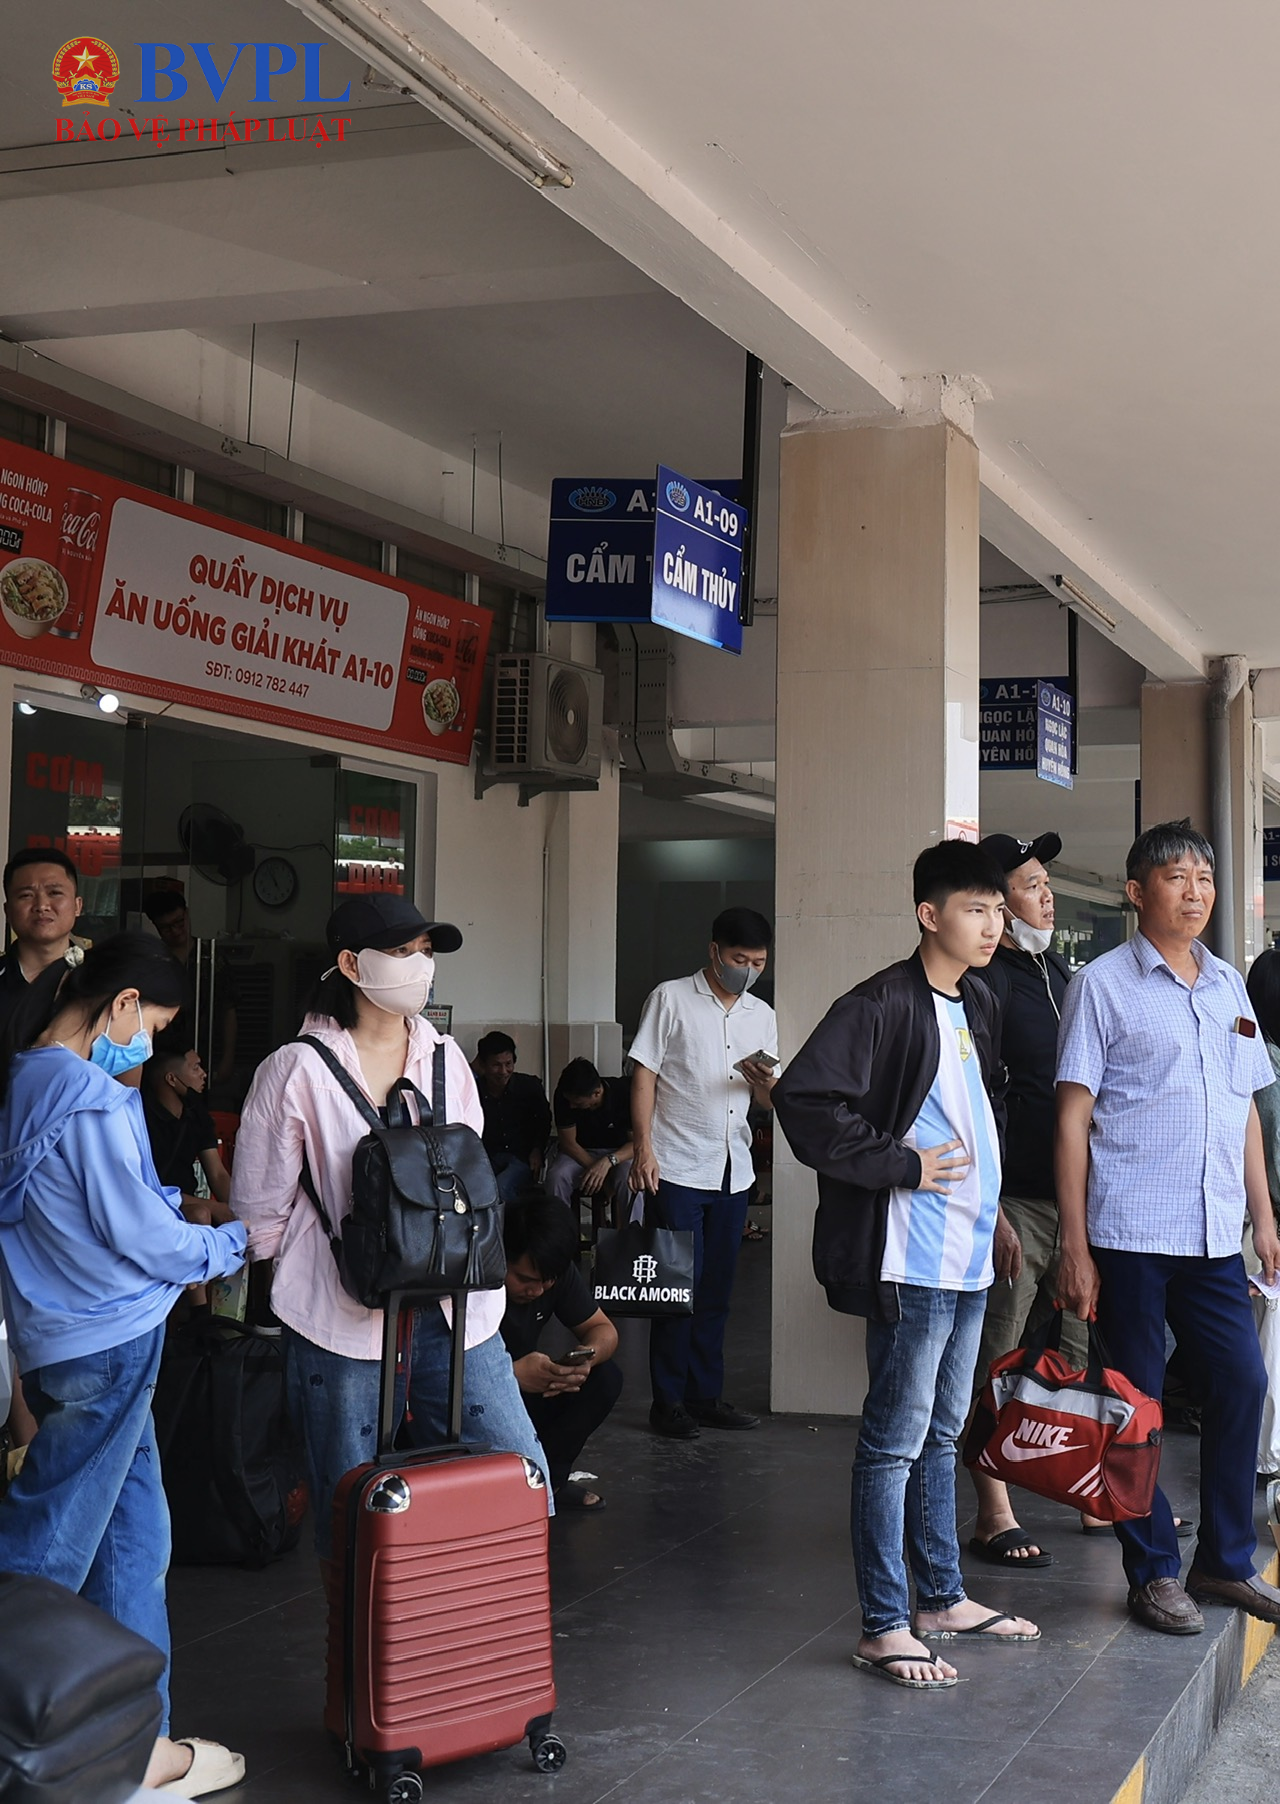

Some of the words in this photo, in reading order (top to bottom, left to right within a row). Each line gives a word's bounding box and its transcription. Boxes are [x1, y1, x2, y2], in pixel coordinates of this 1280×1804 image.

[1, 468, 25, 490] NGON
[25, 476, 49, 498] HƠN?
[8, 496, 53, 524] COCA-COLA
[693, 495, 739, 537] A1-09
[566, 541, 636, 584] CẨM
[663, 544, 698, 597] CẨM
[701, 567, 737, 613] THỦY
[189, 554, 257, 599] QUẦY
[260, 575, 315, 616] DỊCH
[319, 594, 349, 633] VỤ
[104, 578, 149, 626] ĂN
[153, 594, 227, 646] UỐNG
[231, 617, 280, 660] GIẢI
[282, 637, 341, 676] KHÁT
[342, 653, 394, 690] A1-10
[205, 660, 233, 681] SĐT:
[235, 670, 263, 688] 0912
[266, 674, 286, 694] 782
[288, 681, 310, 699] 447
[995, 684, 1037, 699] A1-1
[1017, 706, 1036, 726] LẶ
[1052, 694, 1071, 717] A1-10
[982, 730, 1011, 743] UAN
[27, 752, 104, 799] CƠM
[350, 803, 401, 838] CƠM
[594, 1286, 637, 1301] BLACK
[638, 1287, 691, 1303] AMORIS
[1014, 1418, 1074, 1448] NIKE
